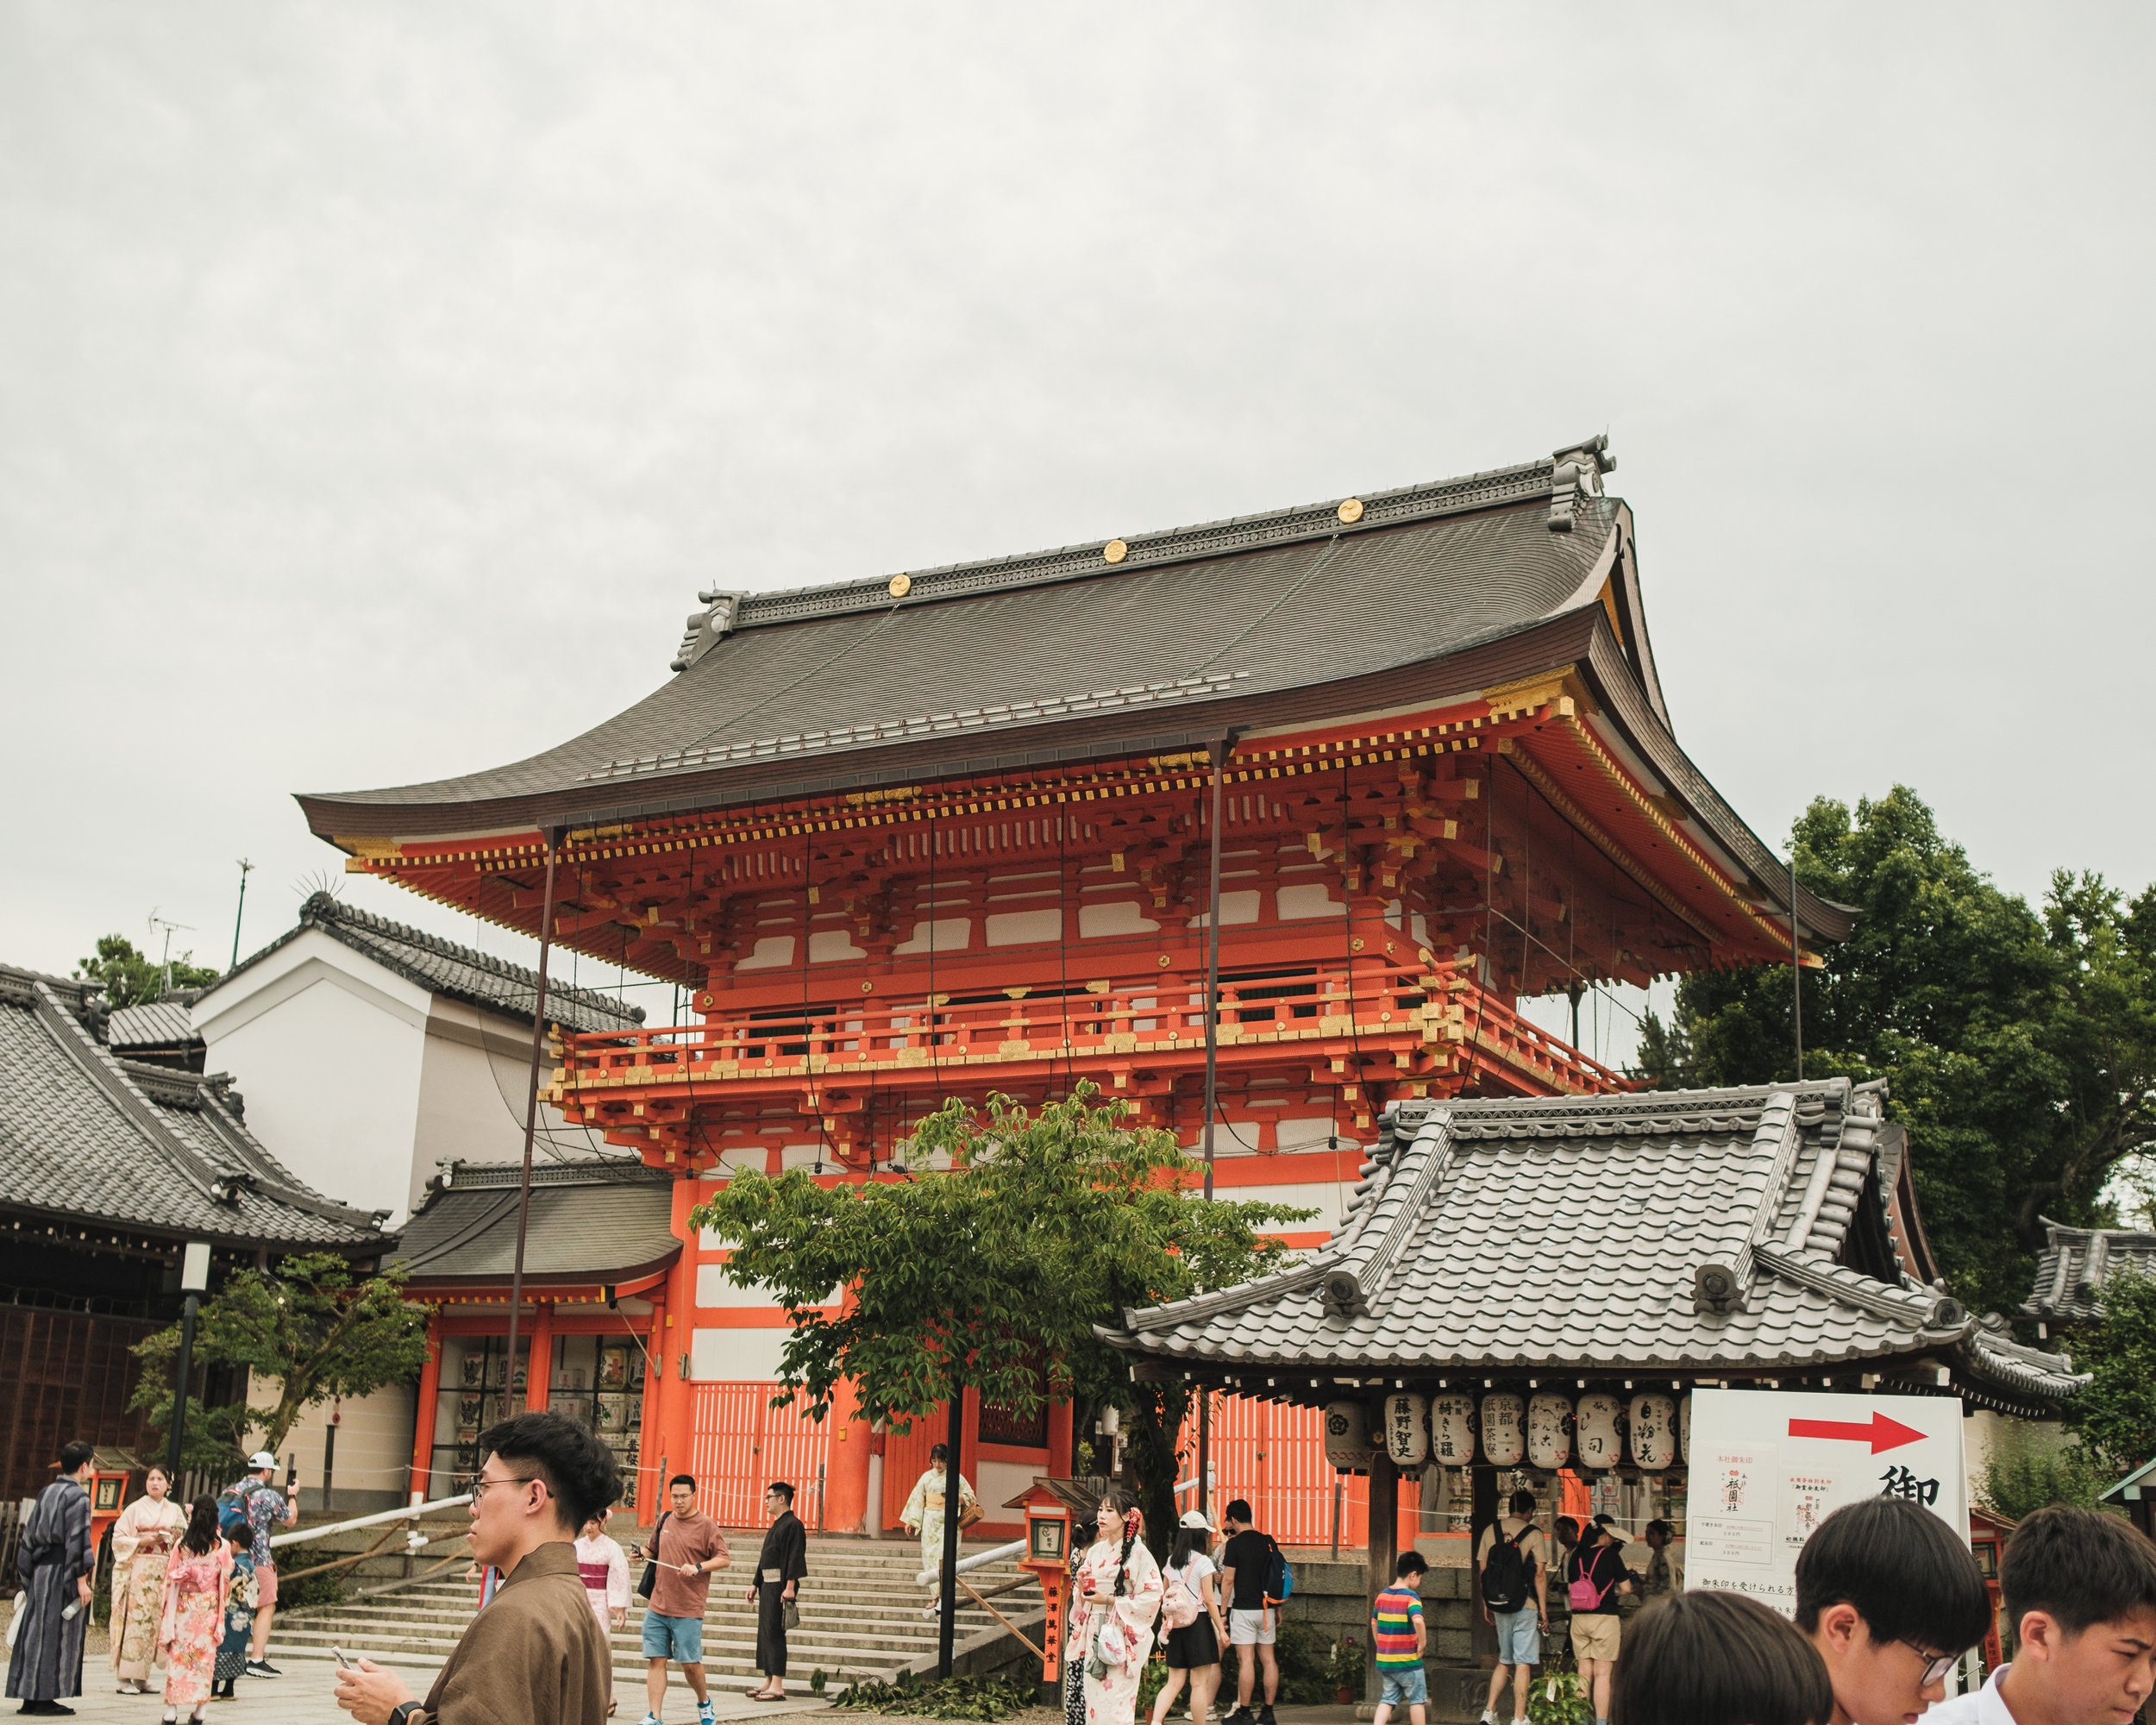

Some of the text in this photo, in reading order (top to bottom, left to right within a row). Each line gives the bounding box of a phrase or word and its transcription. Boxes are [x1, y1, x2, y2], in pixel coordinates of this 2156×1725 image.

[1395, 1396, 1415, 1458] 藤野智史
[1483, 1398, 1497, 1456] 祇園茶寮
[1498, 1397, 1514, 1426] 京都
[1878, 1465, 1940, 1506] 御
